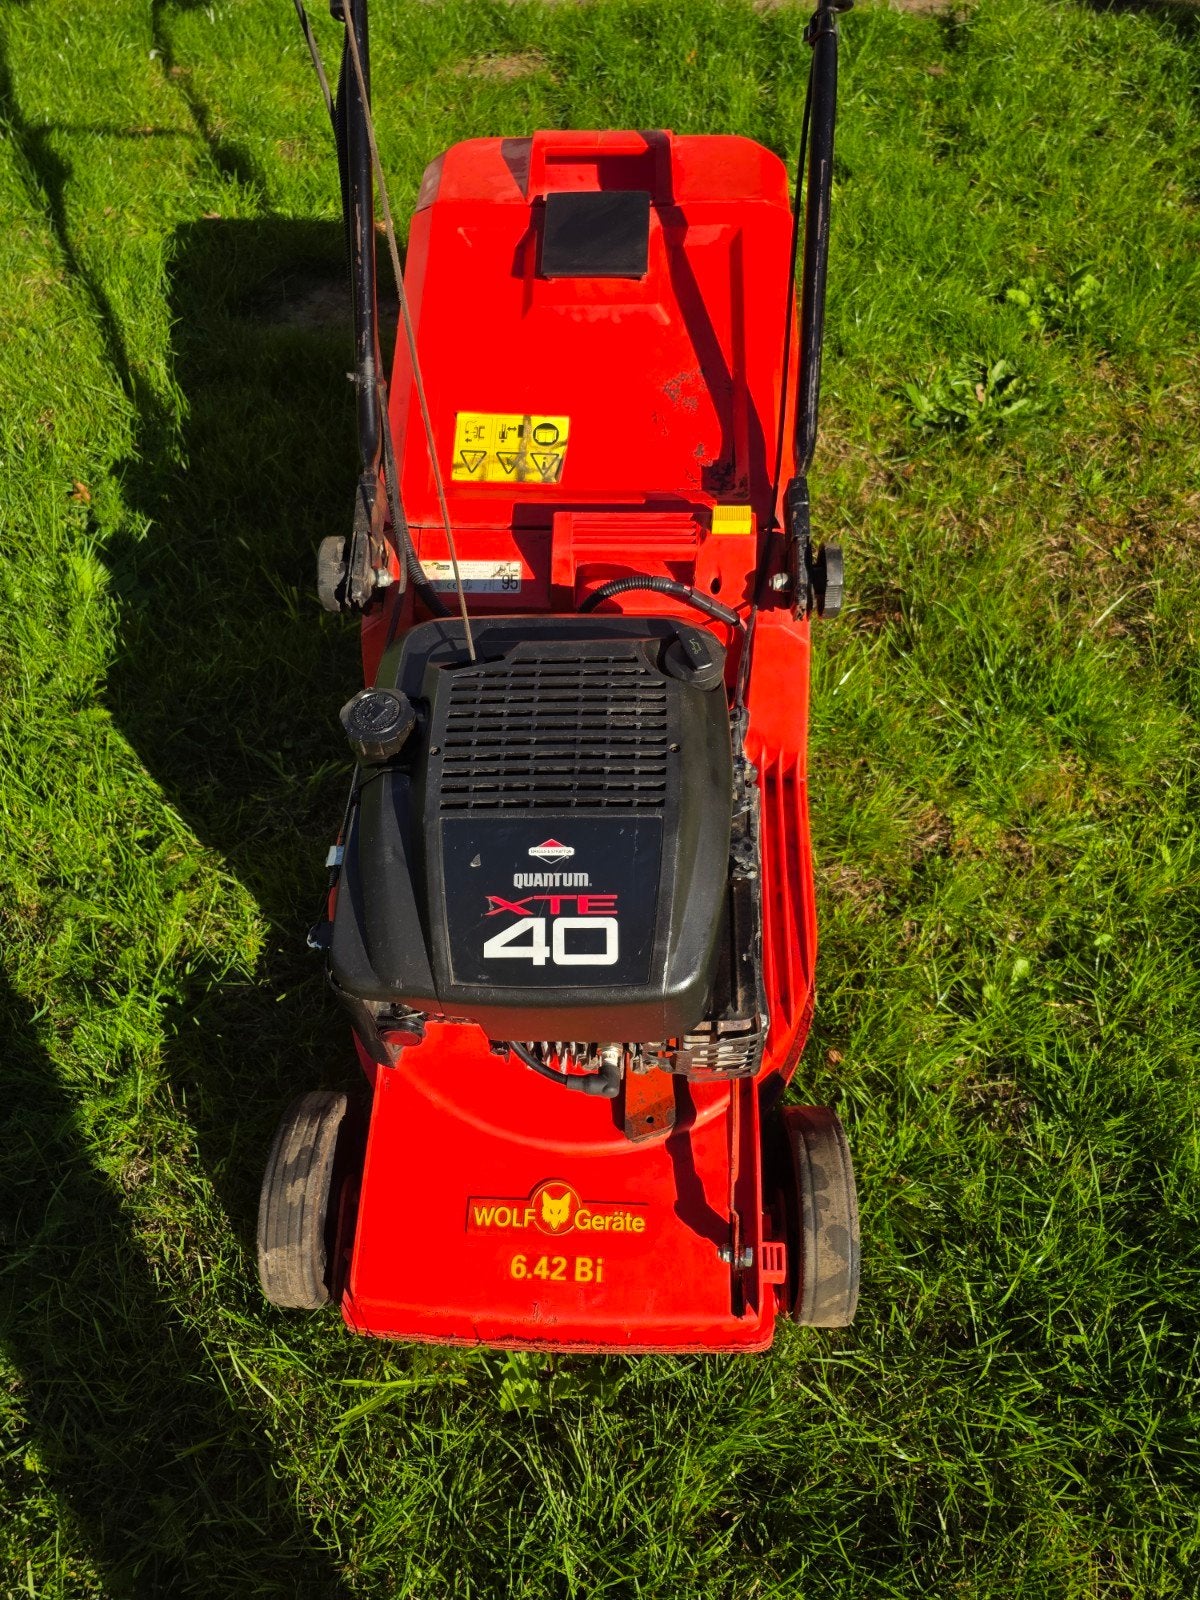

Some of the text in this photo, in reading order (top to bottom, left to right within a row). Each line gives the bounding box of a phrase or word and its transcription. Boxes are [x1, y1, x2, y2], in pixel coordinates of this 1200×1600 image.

[501, 575, 519, 590] 95
[513, 872, 589, 889] QUANTUM
[484, 894, 618, 915] XTE
[483, 917, 618, 966] 40
[473, 1206, 646, 1233] WOLF Geräte
[510, 1254, 604, 1283] 6.42 Bi
